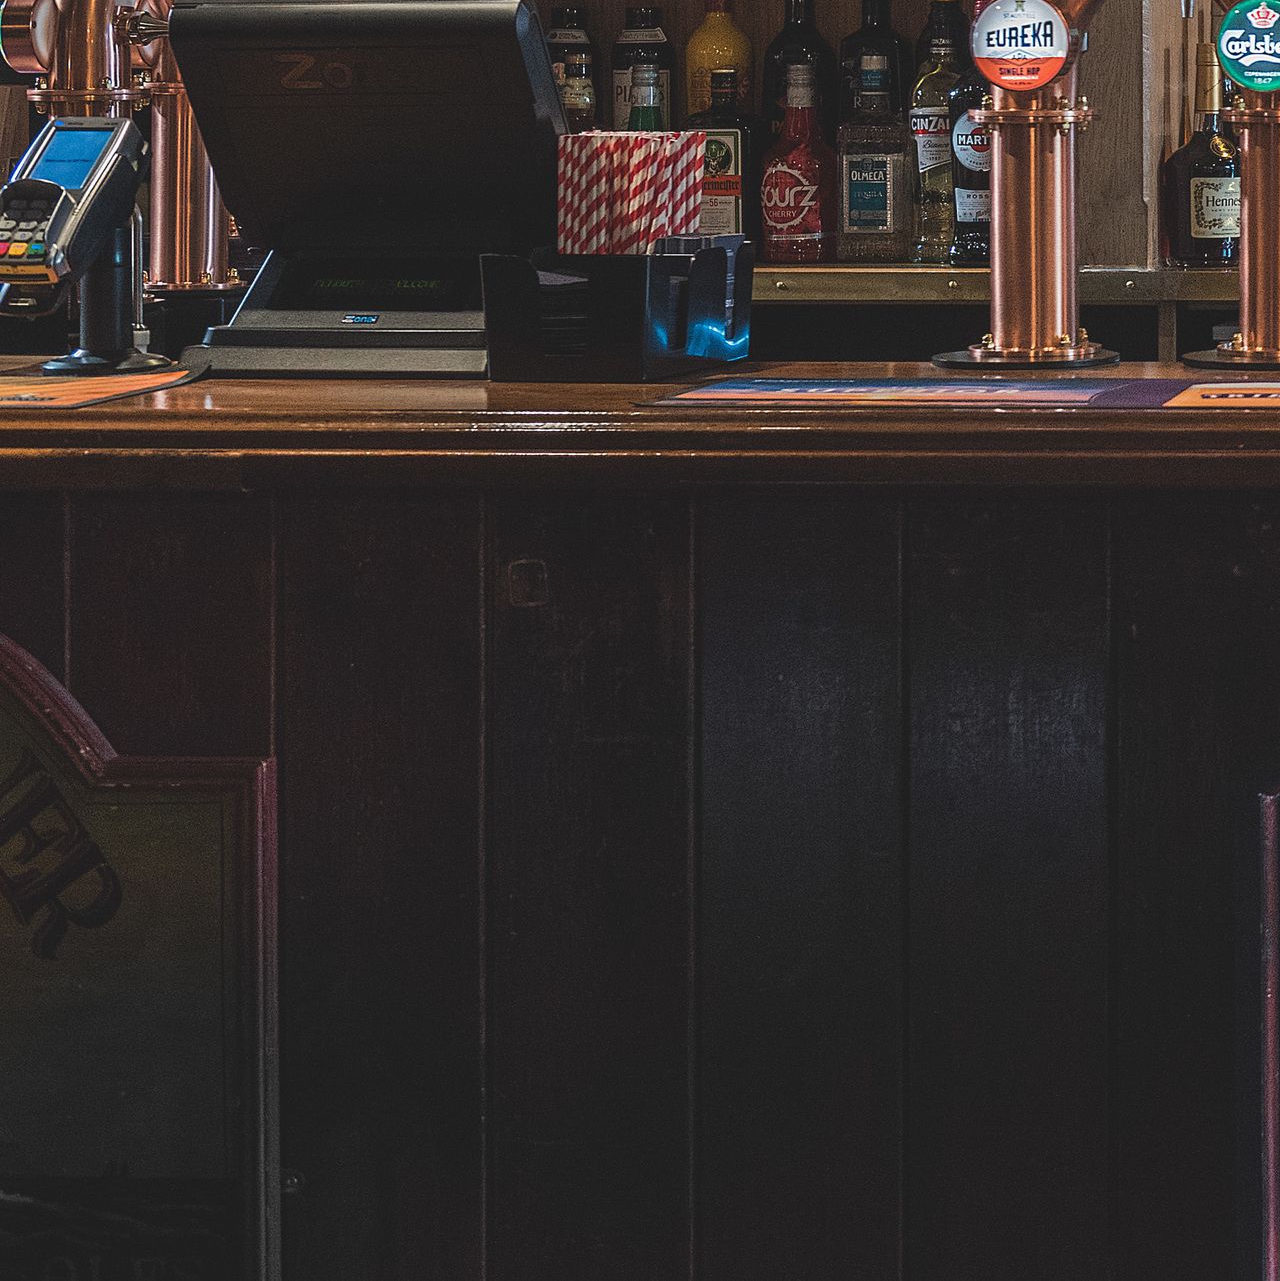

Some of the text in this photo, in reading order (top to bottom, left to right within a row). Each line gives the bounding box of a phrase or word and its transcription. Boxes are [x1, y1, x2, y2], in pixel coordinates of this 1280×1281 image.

[986, 21, 1054, 48] EUREKA
[999, 67, 1041, 76] SINGLE HOP
[851, 170, 885, 180] OLMECA
[769, 209, 797, 218] CHERRY
